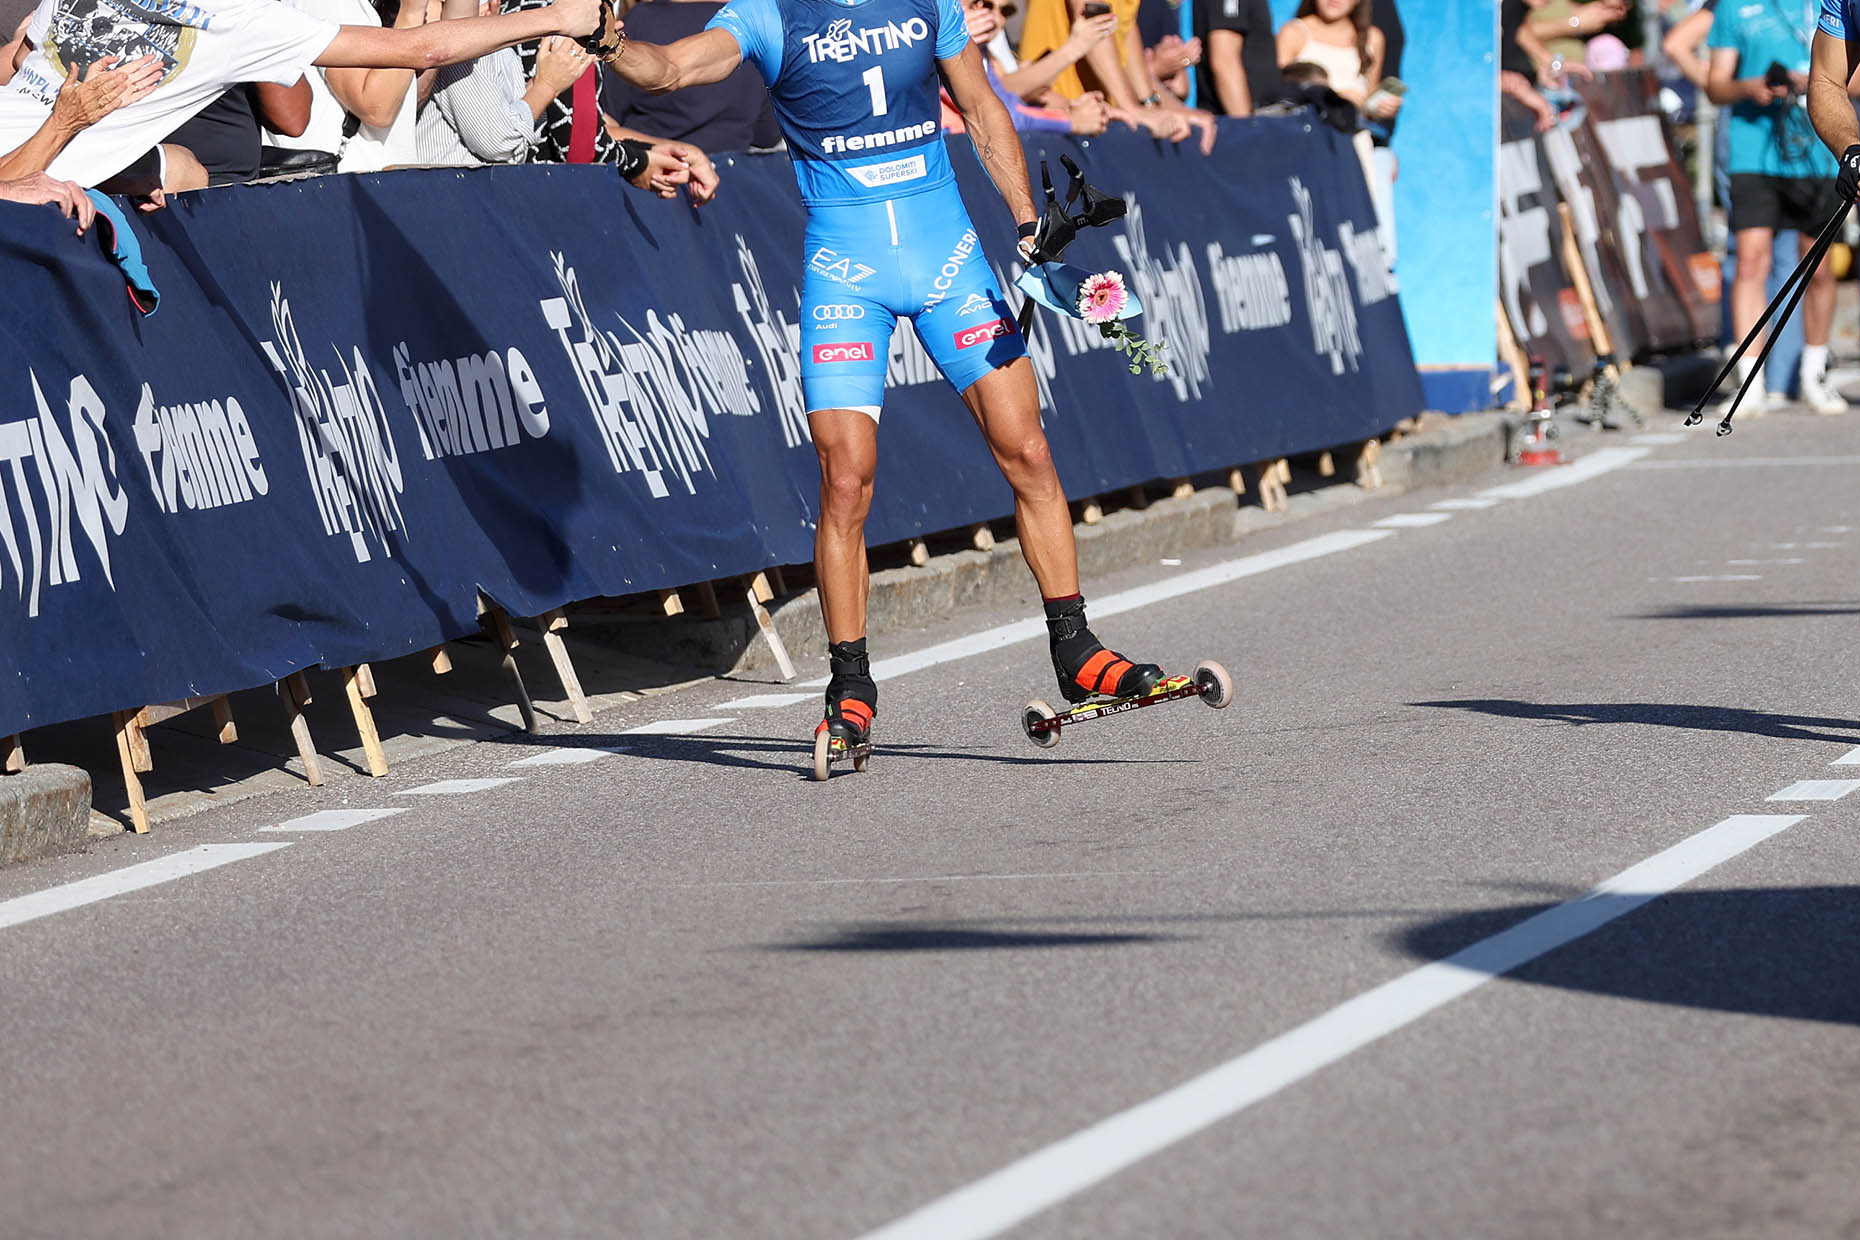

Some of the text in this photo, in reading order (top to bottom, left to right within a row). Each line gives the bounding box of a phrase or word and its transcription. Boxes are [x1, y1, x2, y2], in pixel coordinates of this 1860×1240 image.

[802, 16, 928, 64] TRENTINO
[862, 65, 888, 117] 1
[821, 119, 936, 154] fiemme
[878, 161, 917, 175] DOLOMITI
[879, 167, 919, 182] SUPERSKI
[811, 246, 878, 283] EA7
[815, 322, 838, 331] Audi
[962, 320, 1012, 347] enel
[819, 344, 868, 362] enel
[393, 341, 551, 461] fiemme
